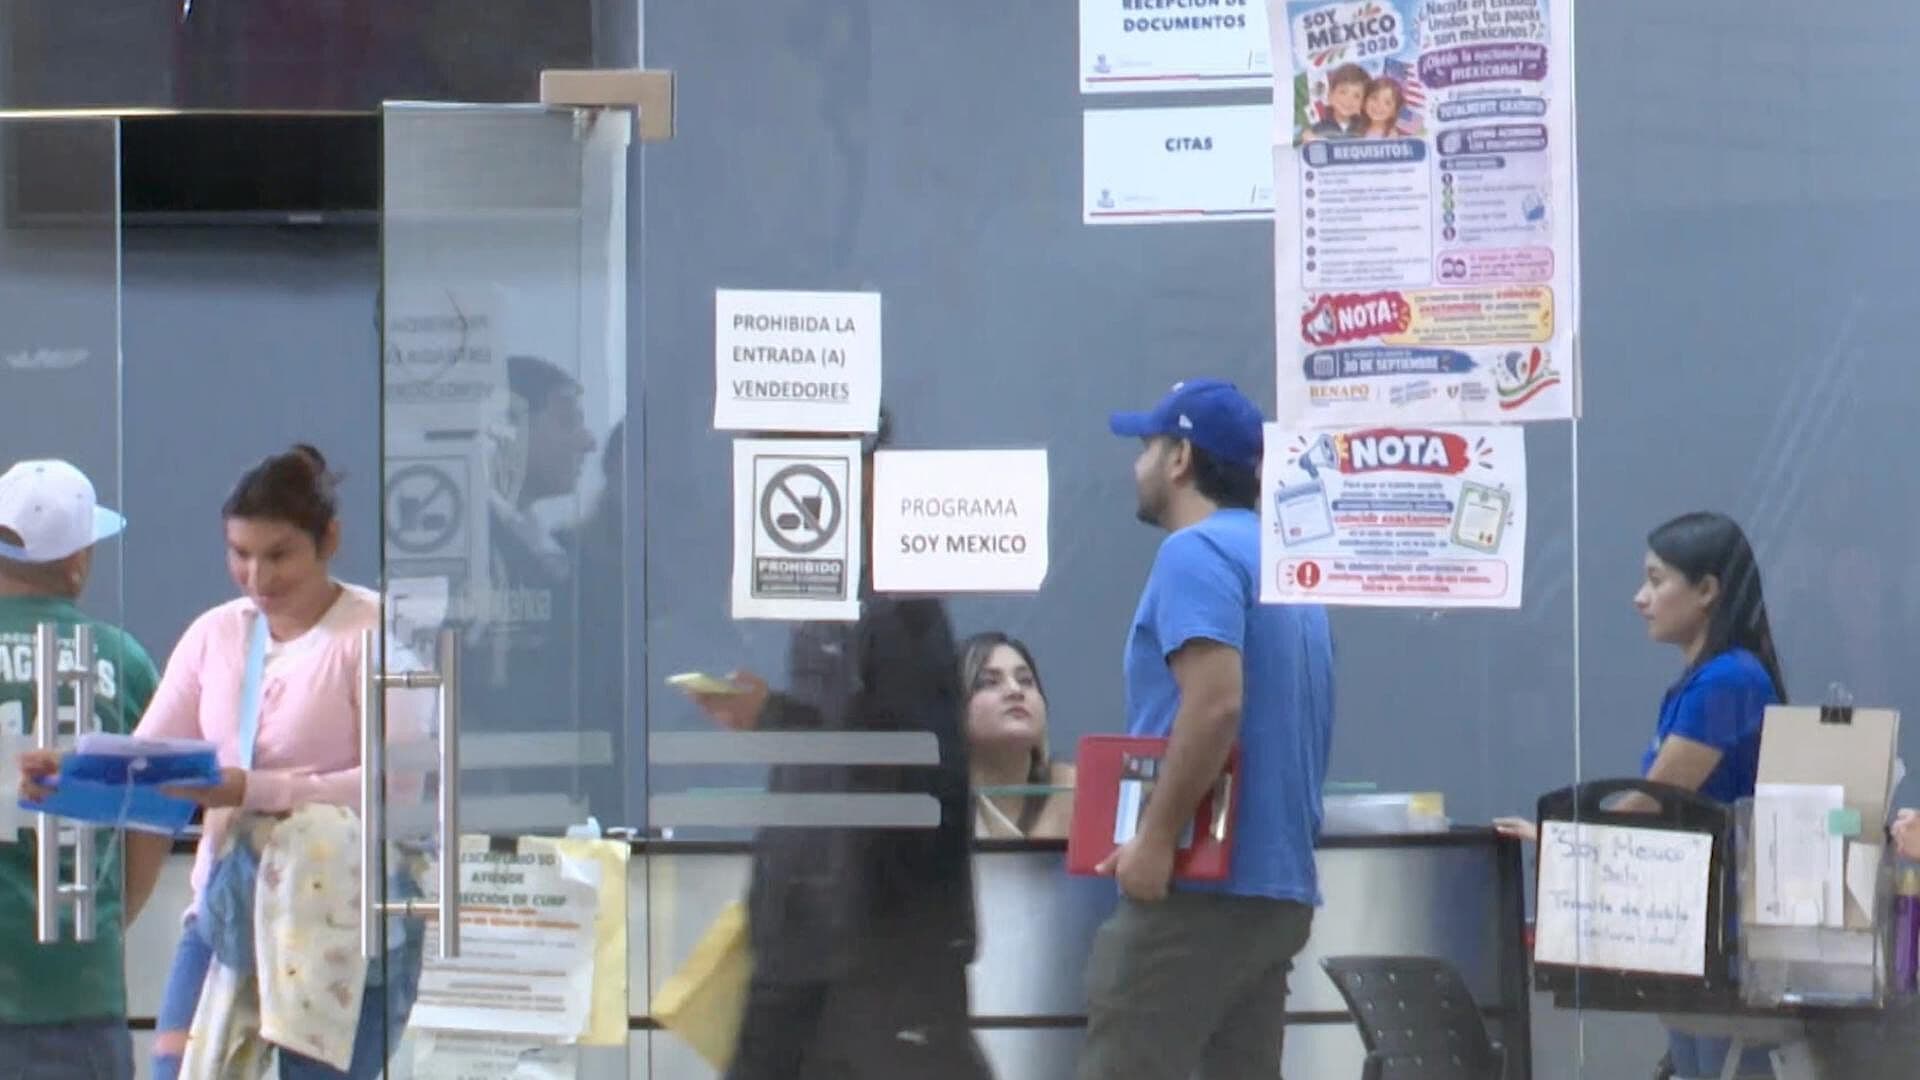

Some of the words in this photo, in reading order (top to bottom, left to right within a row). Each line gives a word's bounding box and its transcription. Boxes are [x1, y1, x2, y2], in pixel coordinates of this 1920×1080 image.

[1122, 14, 1247, 32] DOCUMENTOS
[1303, 8, 1336, 30] SOY
[1357, 34, 1399, 57] 2026
[1434, 32, 1456, 46] son
[1165, 136, 1213, 151] CITAS
[733, 314, 831, 332] PROHIBIDA
[836, 317, 855, 333] LA
[1338, 300, 1399, 331] NOTA:
[733, 345, 817, 364] ENTRADA
[822, 347, 846, 368] (A)
[732, 379, 849, 399] VENDEDORES
[1351, 435, 1450, 469] NOTA
[901, 498, 1018, 517] PROGRAMA
[900, 534, 939, 554] SOY
[946, 534, 1027, 554] MEXICO
[759, 560, 841, 574] PROHIBIDO
